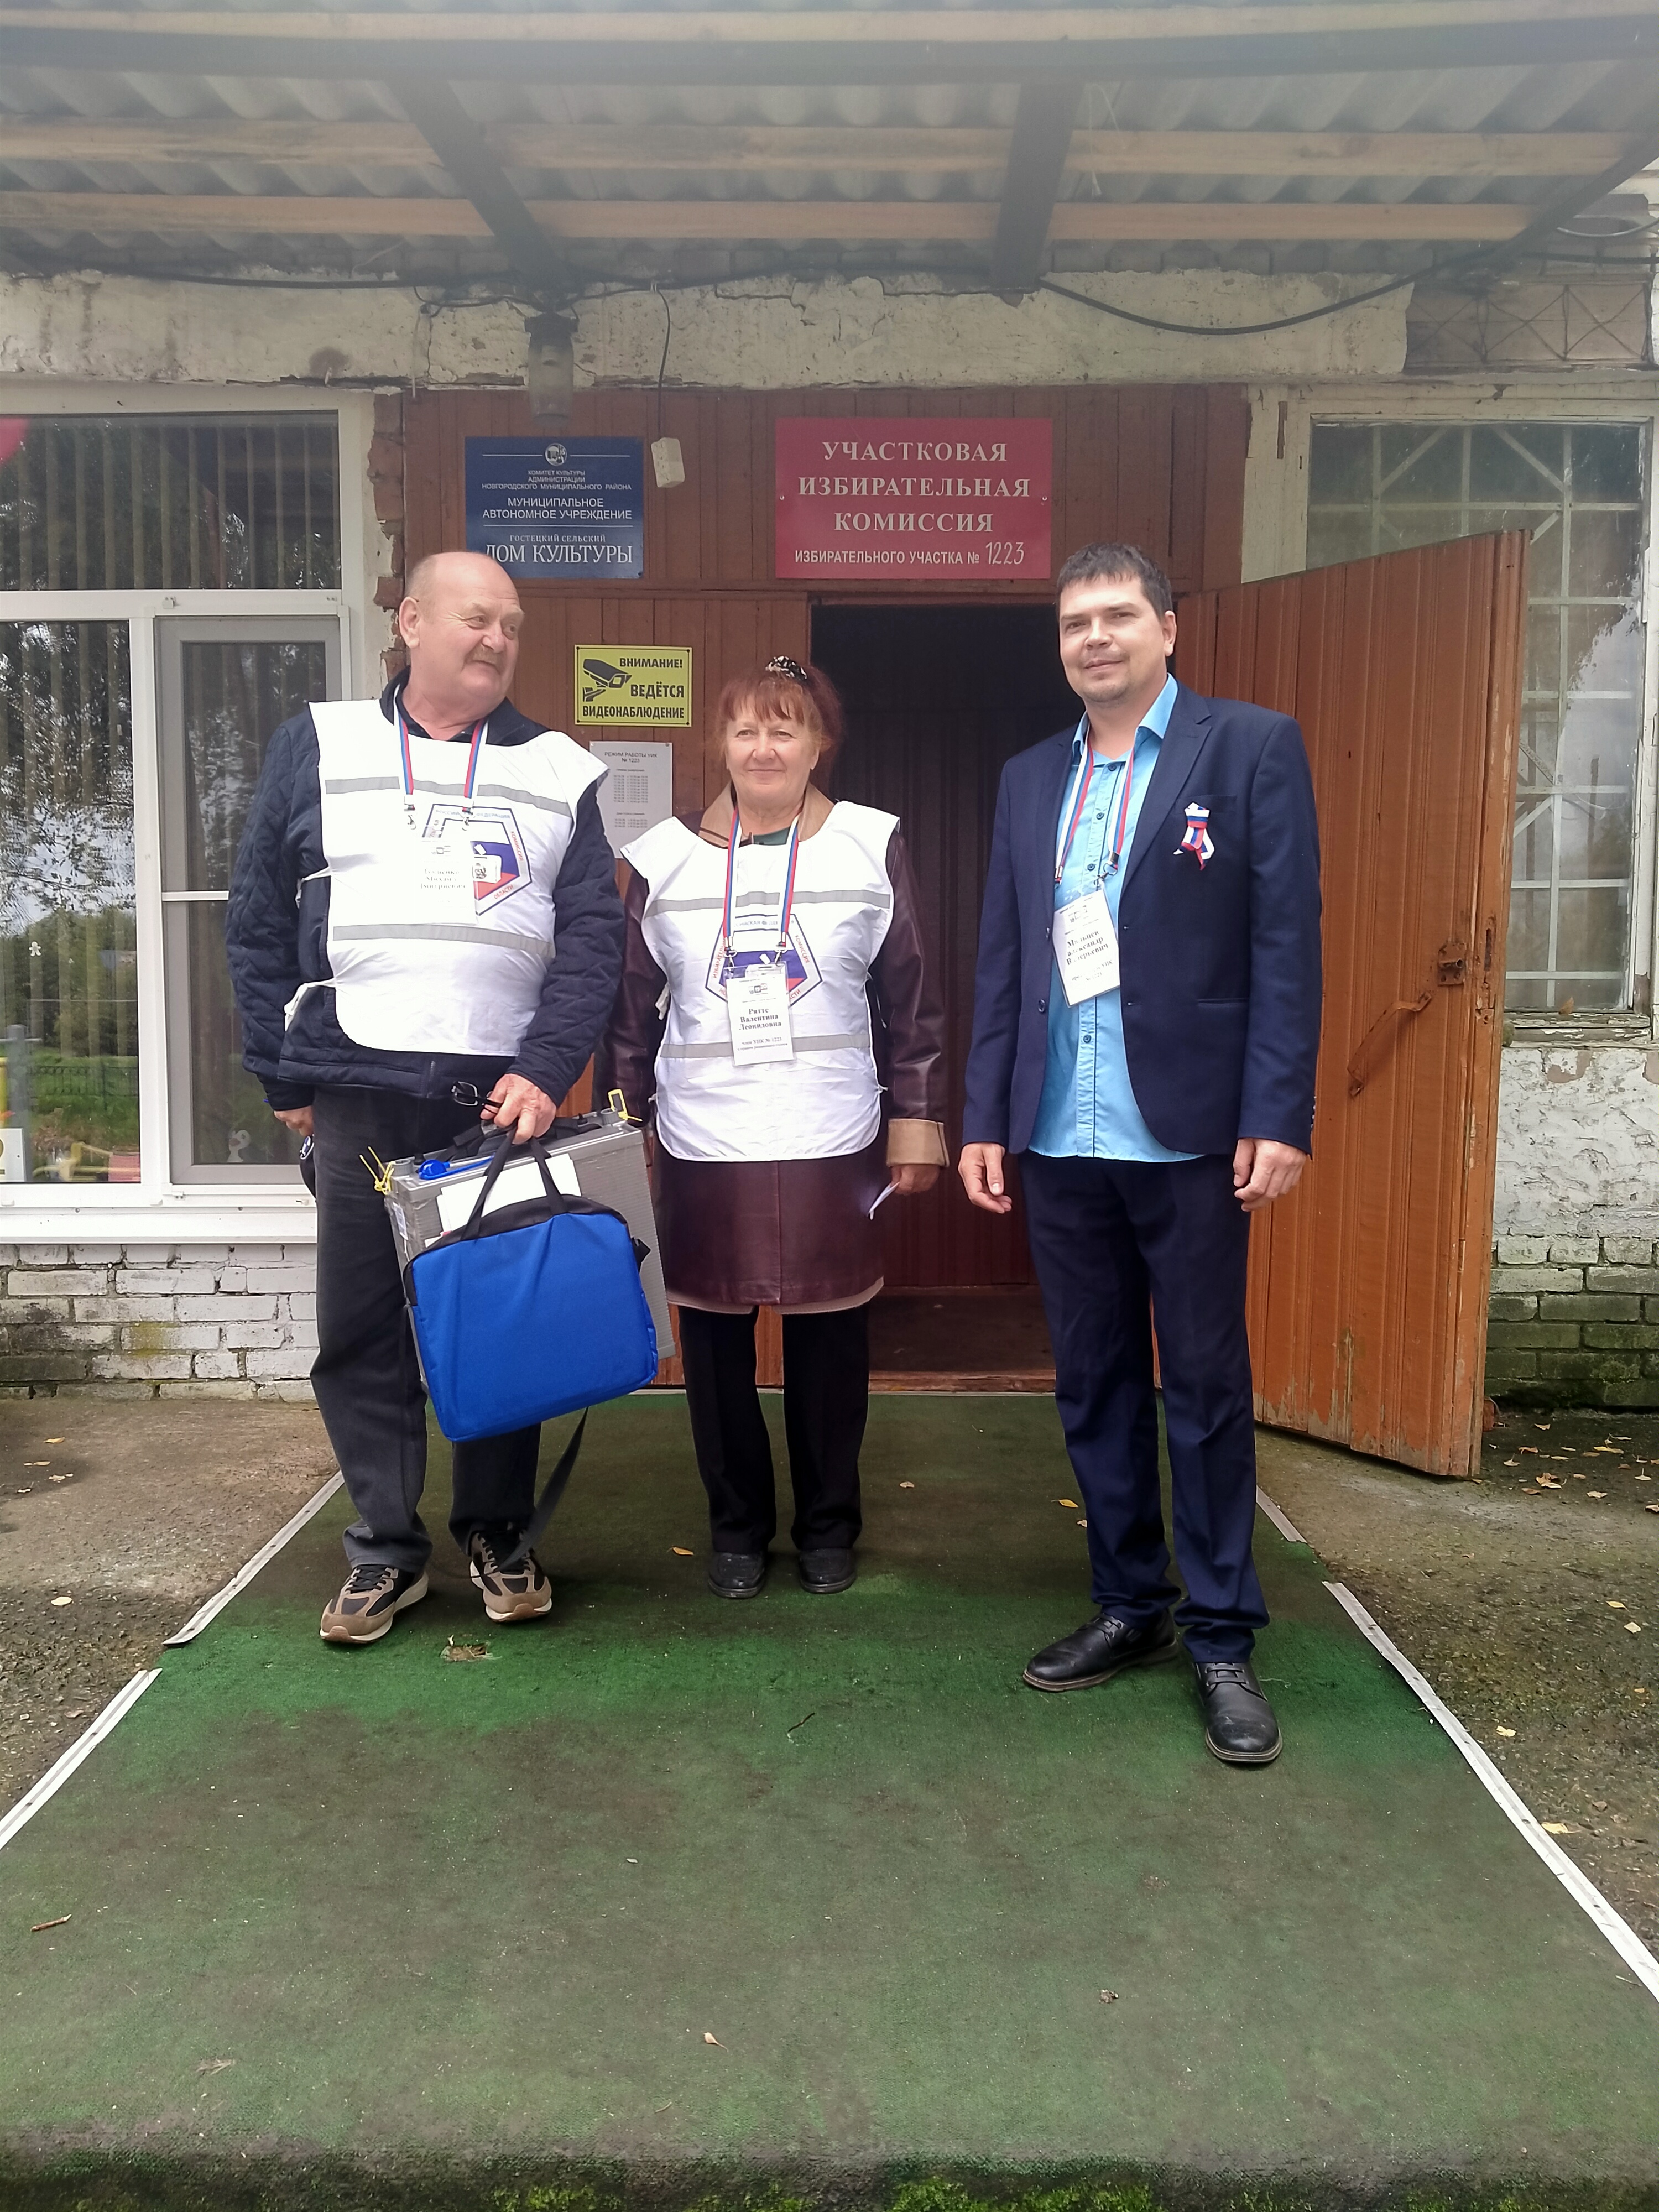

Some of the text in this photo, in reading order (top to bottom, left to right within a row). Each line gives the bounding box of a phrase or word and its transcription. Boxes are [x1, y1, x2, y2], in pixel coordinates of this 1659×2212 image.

[822, 441, 1007, 462] УЧАСТКОВАЯ
[798, 477, 1030, 497] ИЗБИРАТЕЛЬНАЯ
[508, 498, 604, 509] МУНИЦИПАЛЬНОЕ
[482, 509, 632, 520] АВТОНОМНОЕ УЧРЕЖДЕНИЕ
[834, 512, 994, 533] КОМИССИЯ
[510, 534, 606, 543] ГОСТЕЦКИЙ СЕЛЬСКИЙ
[486, 544, 633, 564] ДОМ КУЛЬТУРЫ
[795, 541, 1025, 565] ИЗБИРАТЕЛЬНОГО УЧАСТКА № 1223
[619, 658, 683, 668] ВНИМАНИЕ!
[630, 681, 685, 699] ВЕДЁТСЯ
[582, 706, 685, 719] ВИДЕОНАБЛЮДЕНИЕ
[510, 831, 524, 861] КОМИССИЯ
[493, 884, 514, 900] ОБЛАСТИ
[795, 935, 810, 964] КОМИССИЯ
[739, 1022, 781, 1030] Леонидовна
[740, 1014, 778, 1023] Валентина
